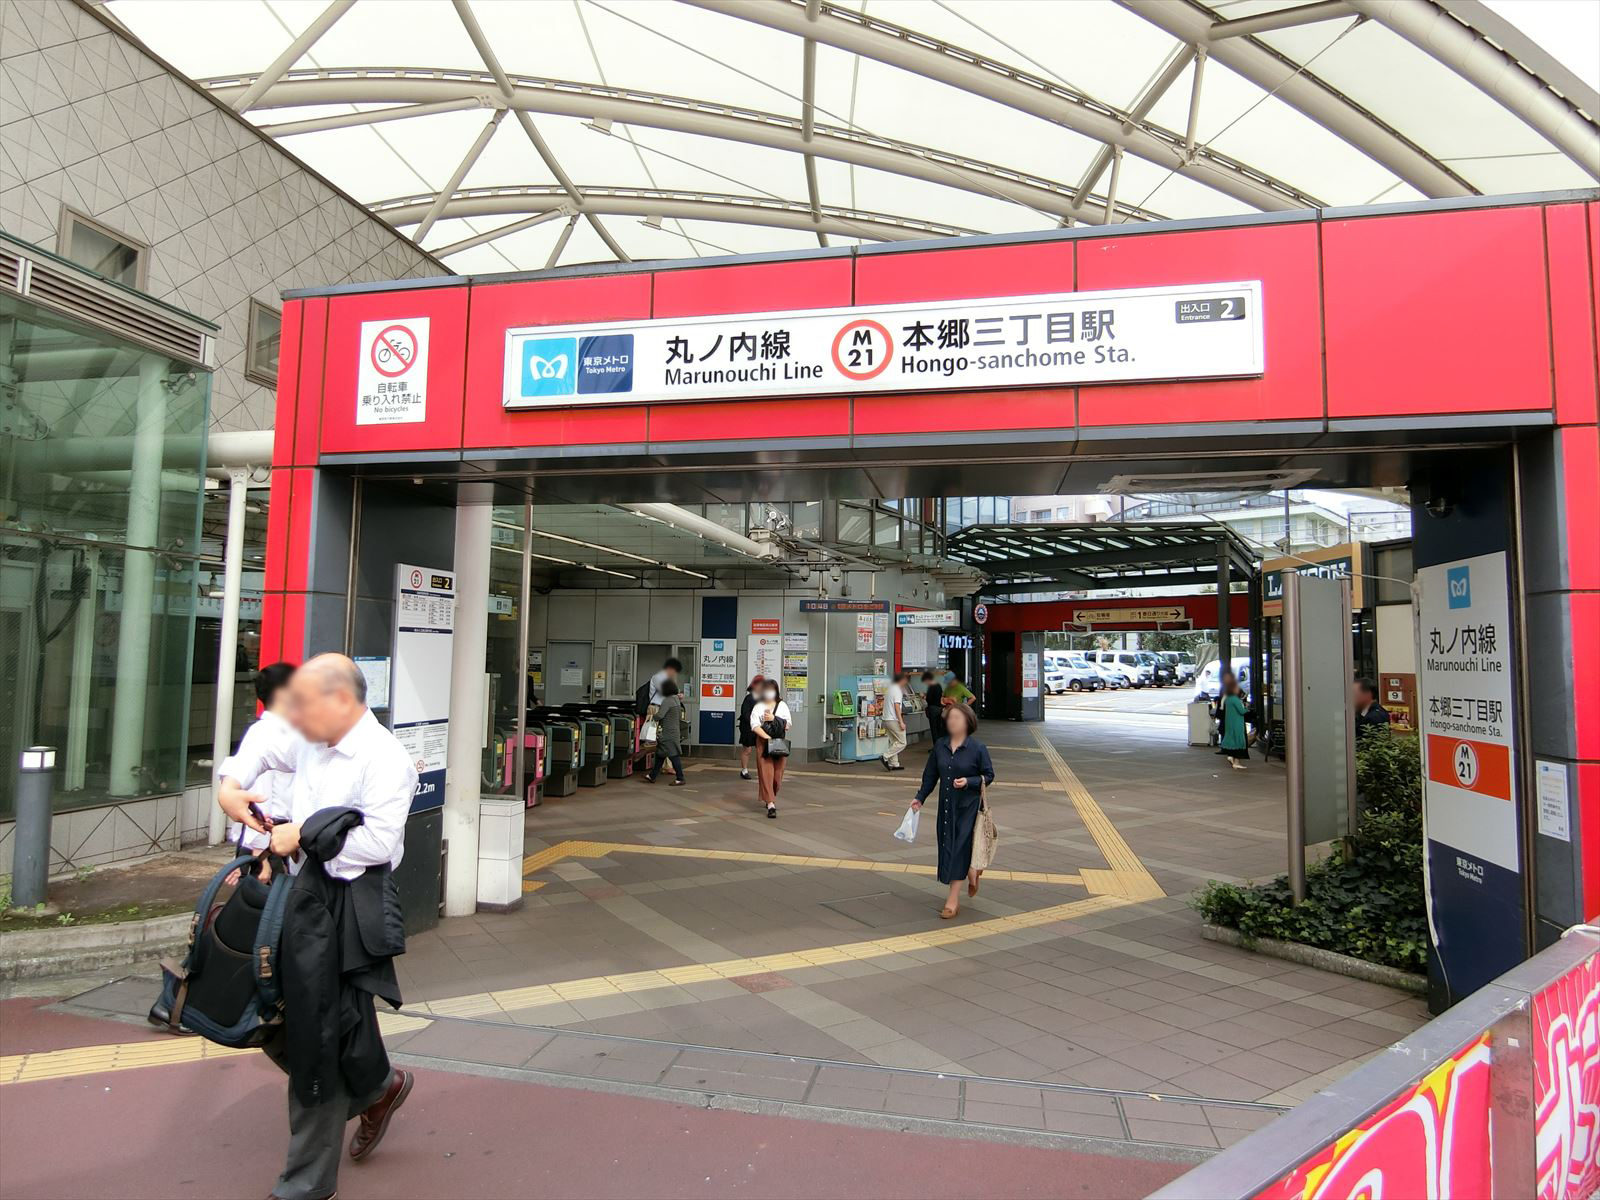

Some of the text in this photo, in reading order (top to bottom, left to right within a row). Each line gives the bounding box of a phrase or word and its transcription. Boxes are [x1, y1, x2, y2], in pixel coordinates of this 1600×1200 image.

[1179, 299, 1235, 319] 出入口 2
[1180, 313, 1211, 321] Entrance
[852, 330, 872, 346] M
[902, 309, 1116, 352] 本郷三丁目駅
[665, 329, 791, 365] 丸ノ内線
[583, 355, 629, 367] 東京メトロ
[848, 349, 873, 367] 21
[901, 345, 1137, 377] Hongo-sanchome Sta.
[585, 365, 626, 376] Tokyo Metro
[664, 361, 824, 386] Marunouchi Line
[377, 381, 409, 394] 自転車
[362, 392, 422, 407] 乗り入れ禁止
[385, 406, 409, 414] bicycles
[444, 578, 450, 589] 2
[1429, 623, 1497, 655] 丸ノ内線
[703, 655, 735, 664] 丸ノ内線
[1427, 657, 1502, 673] Marunouchi Line
[1429, 695, 1503, 724] 本郷三丁目駅
[1429, 717, 1503, 737] Hongo-sanchome Sta.
[1460, 746, 1470, 759] M
[1458, 761, 1472, 779] 21
[415, 783, 435, 795] 2.2m
[1455, 855, 1484, 877] 東京メトロ
[1457, 867, 1483, 884] Tokyo Metro
